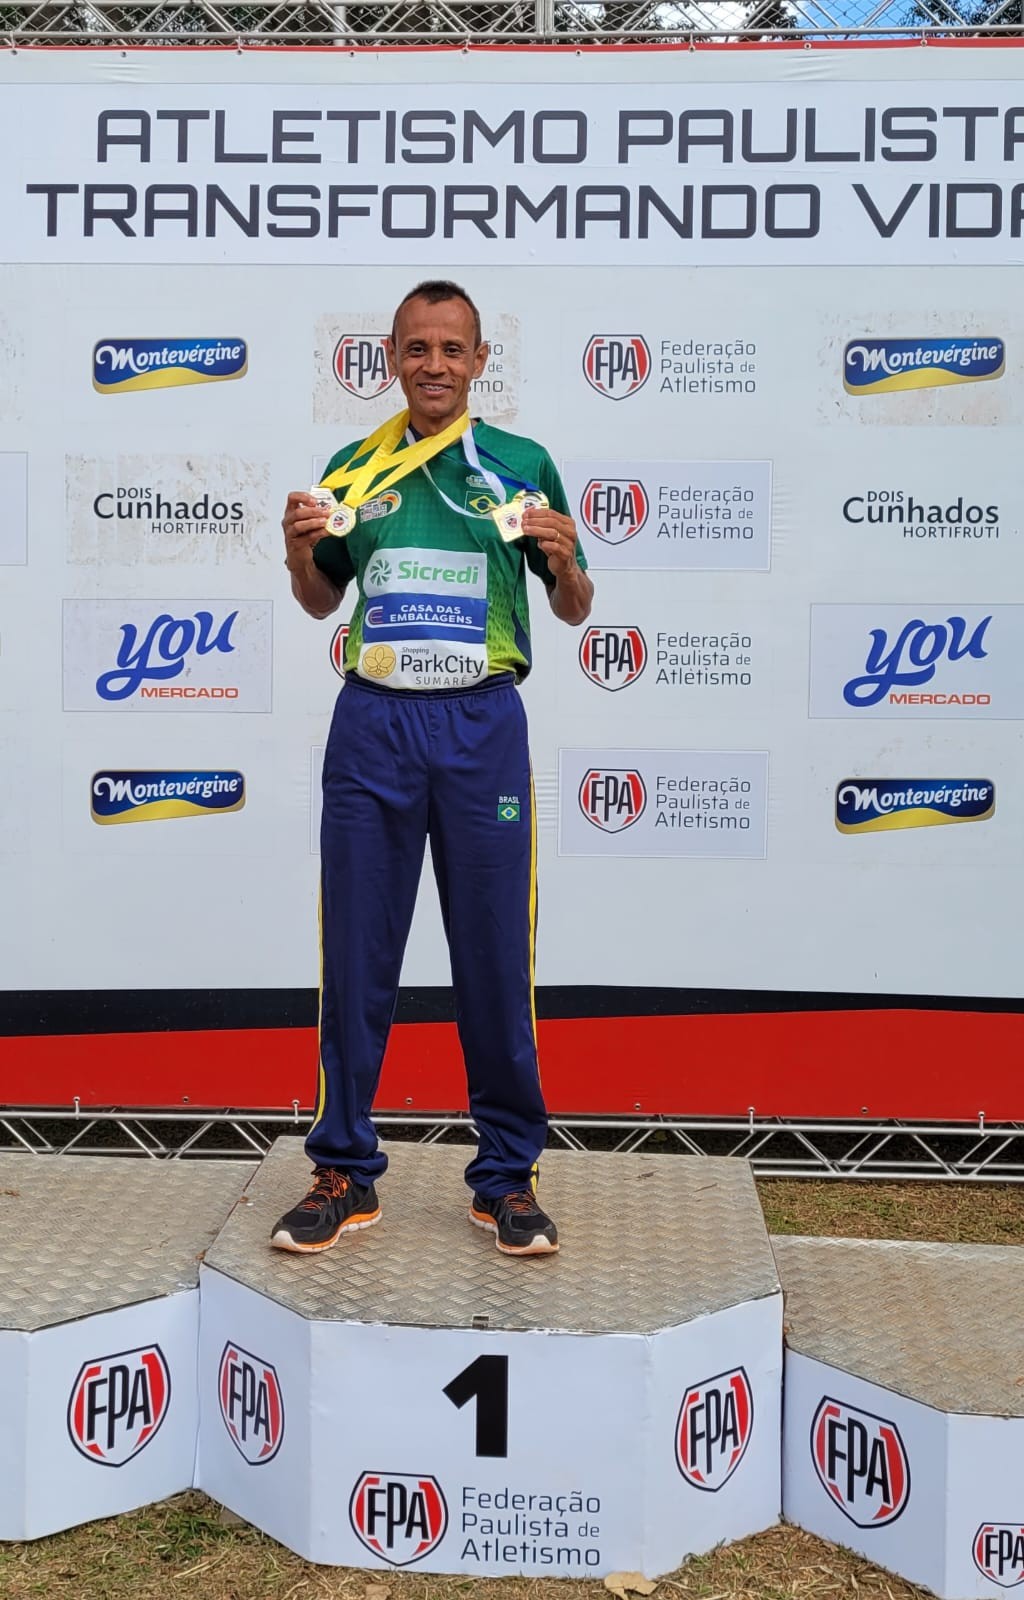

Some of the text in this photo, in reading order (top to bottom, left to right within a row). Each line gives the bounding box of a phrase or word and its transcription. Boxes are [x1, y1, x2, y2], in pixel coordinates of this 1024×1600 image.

[97, 109, 587, 164] ATLETISMO
[26, 183, 1024, 239] TRANSFORMANDO VID
[96, 342, 240, 373] Montevérgine
[661, 339, 756, 358] Federação
[846, 342, 998, 374] Montevérgine
[344, 341, 388, 388] FPA
[595, 341, 638, 389] FPA
[661, 358, 756, 374] Paulista de
[659, 376, 756, 393] Atletismo
[117, 487, 152, 499] DOIS
[658, 485, 754, 505] Federação
[867, 490, 904, 503] DOIS
[93, 494, 244, 520] Cunhados
[592, 486, 636, 533] FPA
[658, 504, 753, 520] Paulista de
[842, 496, 1000, 524] Cunhados
[151, 522, 244, 534] HORTIFRUTI
[656, 521, 754, 540] Atletismo
[903, 526, 1000, 539] HORTIFRUTI
[397, 560, 479, 584] Sicredi
[390, 614, 473, 625] EMBALAGENS
[401, 604, 461, 615] CASA DAS
[402, 646, 429, 654] Shopping
[656, 632, 752, 651] Federação
[401, 654, 484, 678] ParkCity
[591, 633, 634, 680] FPA
[656, 650, 751, 666] Paulista de
[415, 676, 467, 686] SUMARÉ
[655, 667, 752, 685] Atletismo
[141, 687, 239, 699] MERCADO
[889, 693, 991, 705] MERCADO
[94, 775, 237, 805] Montevérgine
[656, 776, 751, 795] Federação
[498, 795, 520, 804] BRASIL
[590, 776, 634, 822] FPA
[656, 793, 750, 810] Paulista de
[839, 784, 988, 813] Montevérgine
[654, 811, 750, 829] Atletismo
[87, 1364, 153, 1449] FPA
[229, 1356, 271, 1444] FPA
[442, 1355, 509, 1458] 1
[690, 1387, 739, 1475] FPA
[828, 1418, 892, 1504] FPA
[462, 1487, 601, 1515] Federação
[367, 1482, 430, 1548] FPA
[462, 1511, 600, 1537] Paulista de
[461, 1539, 601, 1566] Atletismo
